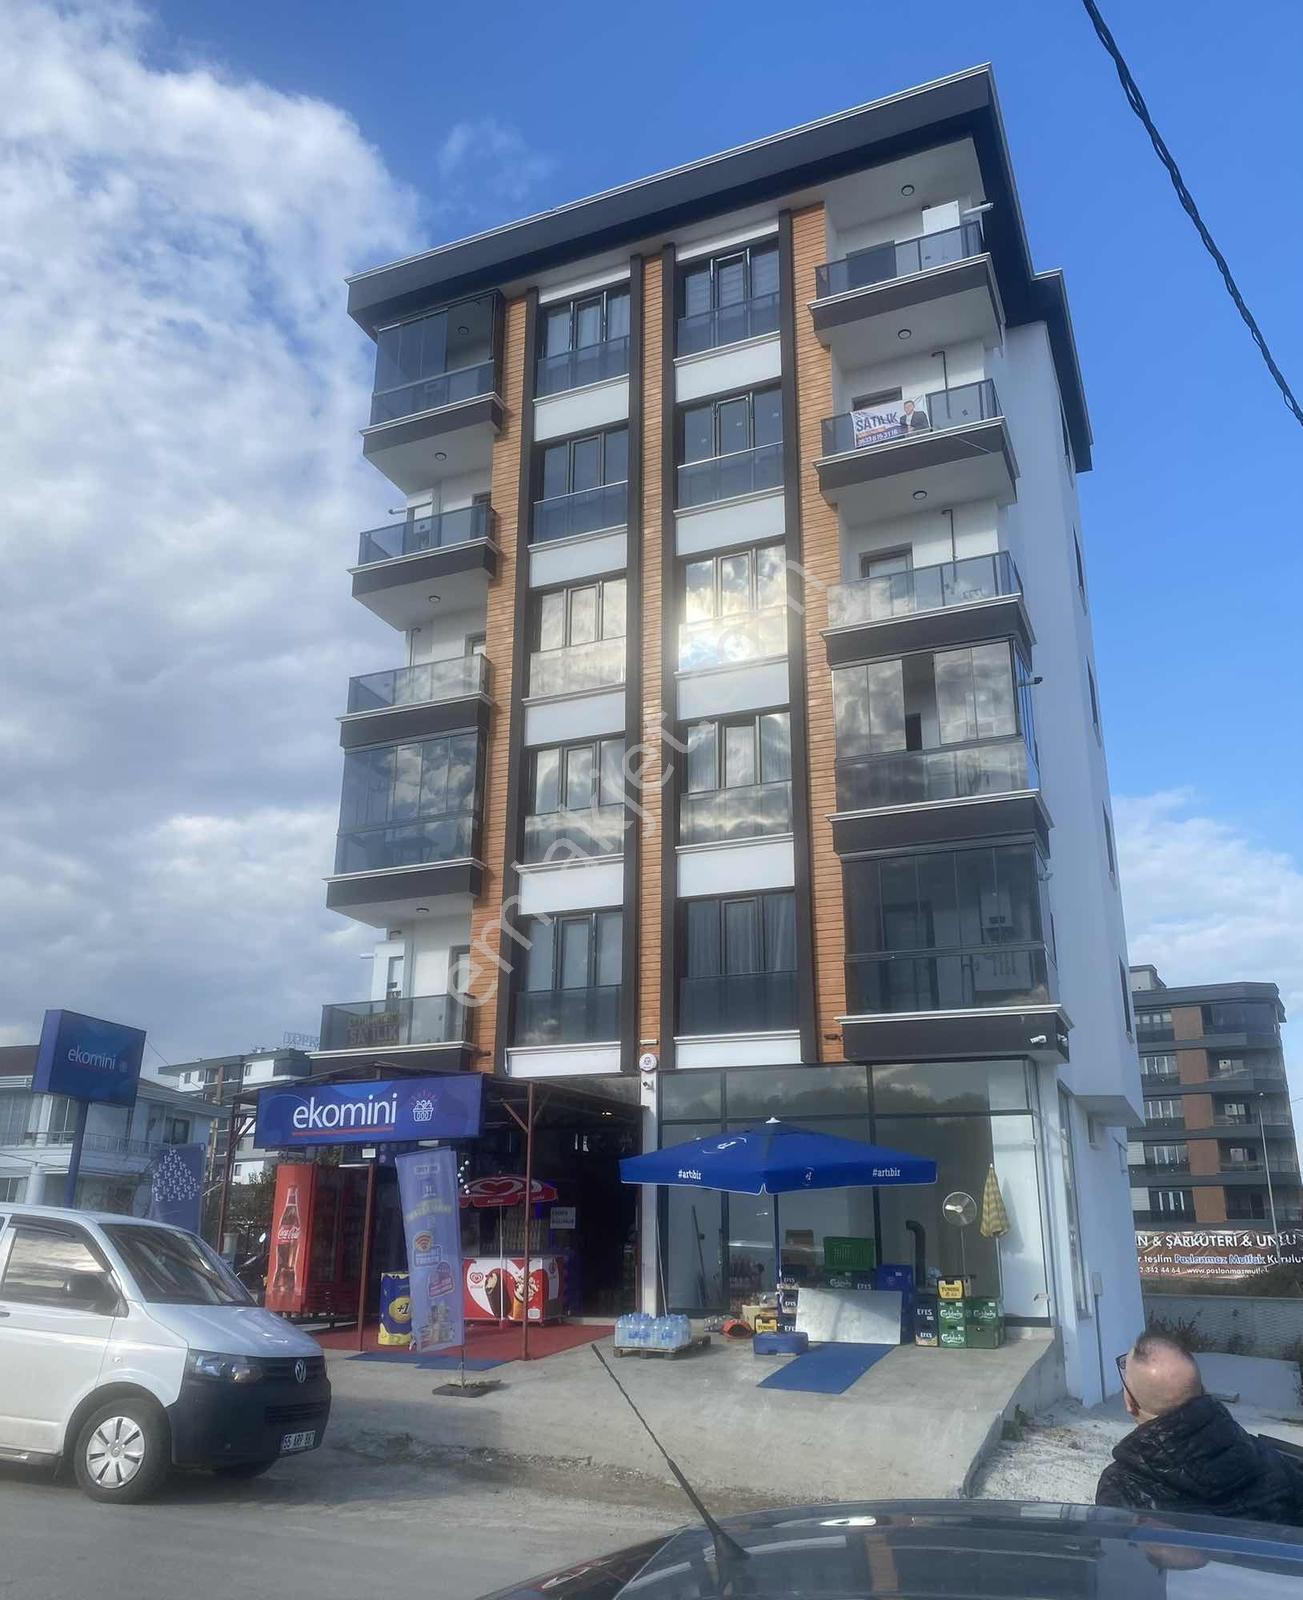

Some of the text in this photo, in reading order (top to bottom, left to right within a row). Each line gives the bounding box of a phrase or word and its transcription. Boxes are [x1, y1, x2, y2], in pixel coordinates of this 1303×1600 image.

[856, 412, 898, 431] SATILIK
[68, 1045, 116, 1070] ekomini
[293, 1093, 397, 1128] ekomini
[1152, 1235, 1162, 1247] &
[1166, 1232, 1237, 1250] ŞARKÜTERİ
[1241, 1234, 1252, 1247] &
[1144, 1253, 1172, 1263] teslim
[1174, 1253, 1228, 1265] Paslanmaz
[1229, 1253, 1266, 1265] Mutfak
[1267, 1253, 1303, 1265] Kurulu
